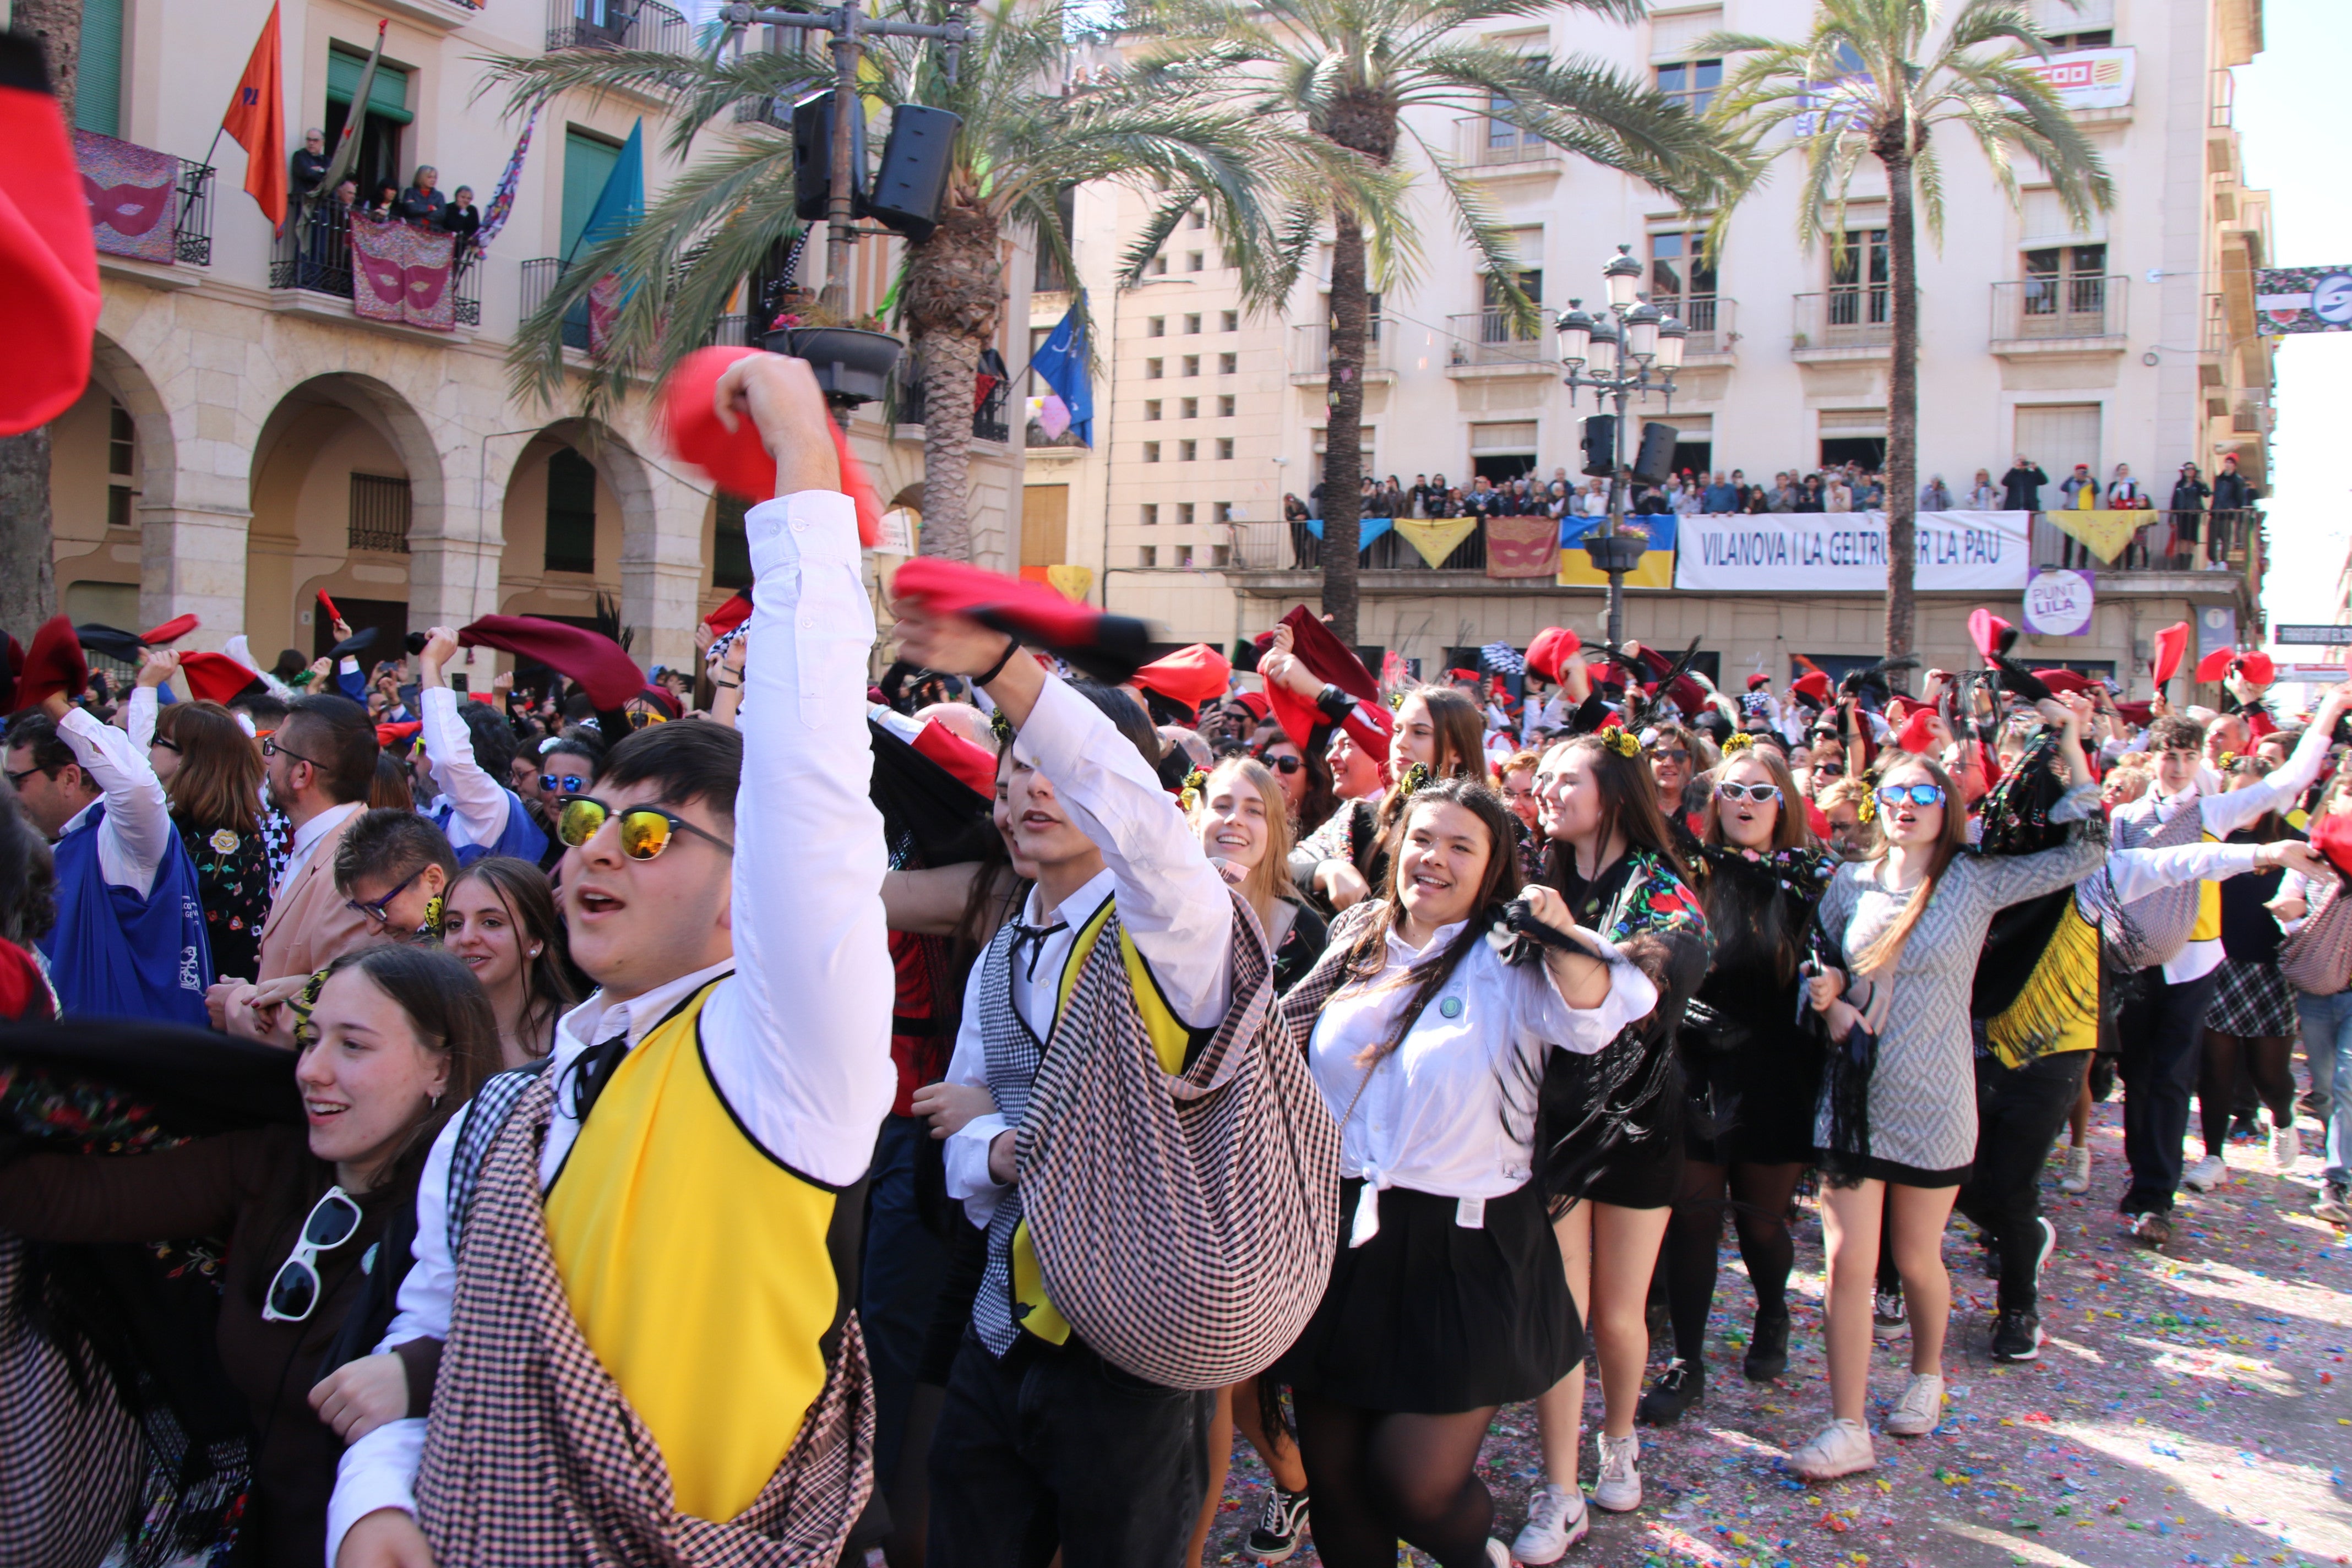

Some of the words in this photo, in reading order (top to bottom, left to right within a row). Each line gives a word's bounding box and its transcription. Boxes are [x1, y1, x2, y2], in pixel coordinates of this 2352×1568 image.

[1701, 532, 1788, 566] VILANOVA
[1793, 532, 1799, 566] I
[1803, 532, 1823, 566] LA
[1937, 530, 1959, 564] LA
[1965, 529, 2001, 564] PAU
[2033, 583, 2076, 600] PUNT
[2035, 598, 2076, 614] LILA
